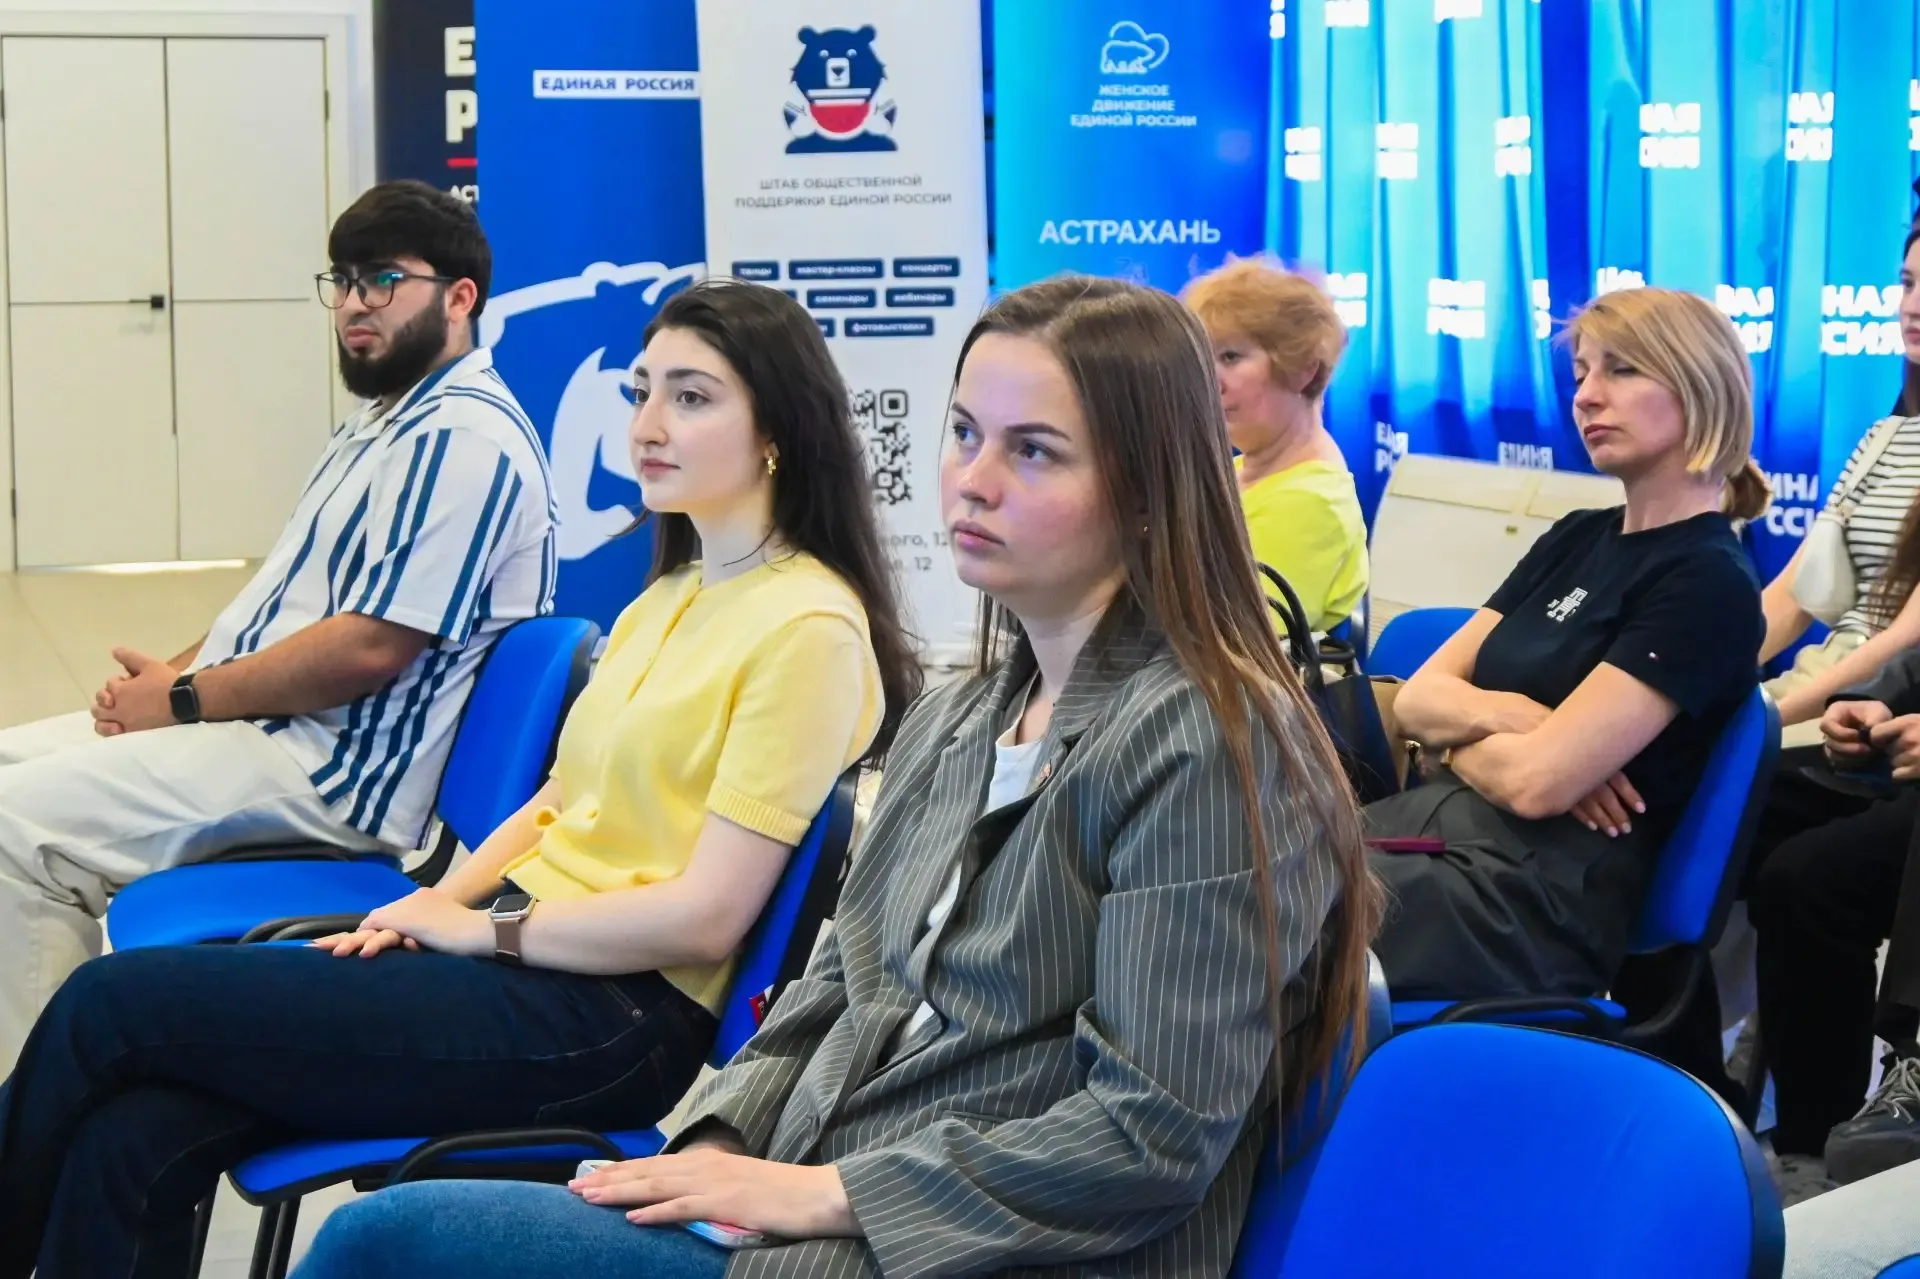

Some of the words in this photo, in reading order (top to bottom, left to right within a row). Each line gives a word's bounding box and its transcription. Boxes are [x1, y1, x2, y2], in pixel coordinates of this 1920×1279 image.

[540, 77, 617, 92] ЕДИНАЯ
[625, 77, 695, 91] РОССИЯ
[1098, 84, 1170, 96] ЖЕНСКОЕ
[1091, 99, 1176, 112] ДВИЖЕНИЕ
[1070, 112, 1133, 127] ЕДИНОЙ
[1136, 114, 1197, 126] РОССИИ
[760, 177, 799, 190] ШТАБ
[803, 174, 922, 189] ОБЩЕСТВЕННОЙ
[735, 195, 825, 209] ПОДДЕРЖКИ
[830, 193, 890, 207] ЕДИНОЙ
[894, 193, 952, 205] РОССИИ
[1038, 219, 1221, 244] АСТРАХАНЬ
